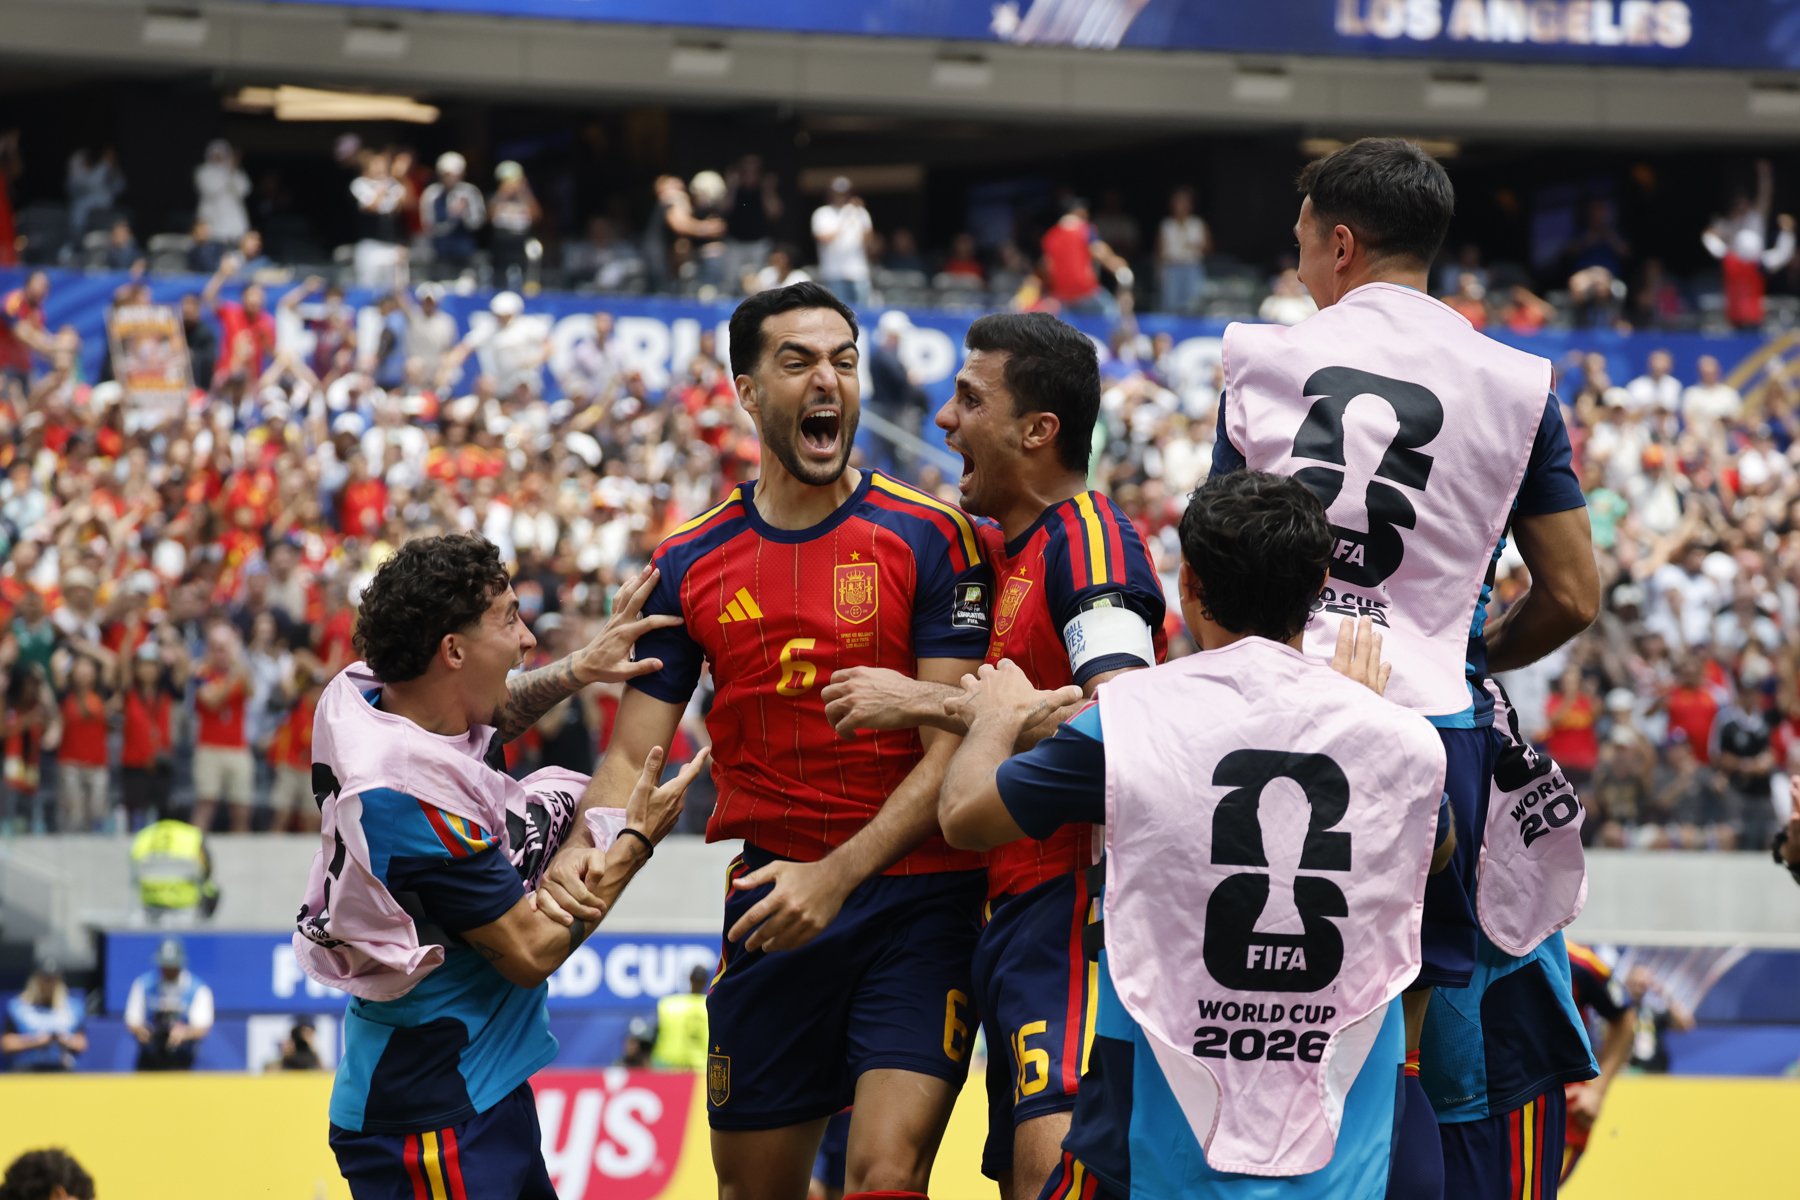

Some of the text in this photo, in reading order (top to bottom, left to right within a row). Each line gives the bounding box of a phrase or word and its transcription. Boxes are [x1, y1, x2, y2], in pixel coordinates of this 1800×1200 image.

[1335, 0, 1692, 48] LOS ANGELES
[1332, 538, 1365, 567] FA
[1065, 620, 1083, 639] BALL
[1068, 629, 1084, 651] TES
[776, 637, 817, 696] 6
[1510, 776, 1567, 822] WORL
[1520, 793, 1581, 849] 20
[605, 943, 718, 998] CUP
[1246, 944, 1308, 971] FIFA
[943, 988, 968, 1062] 6
[1197, 999, 1337, 1024] WORLD CUP
[1192, 1026, 1332, 1063] 2026
[532, 1066, 664, 1200] y's
